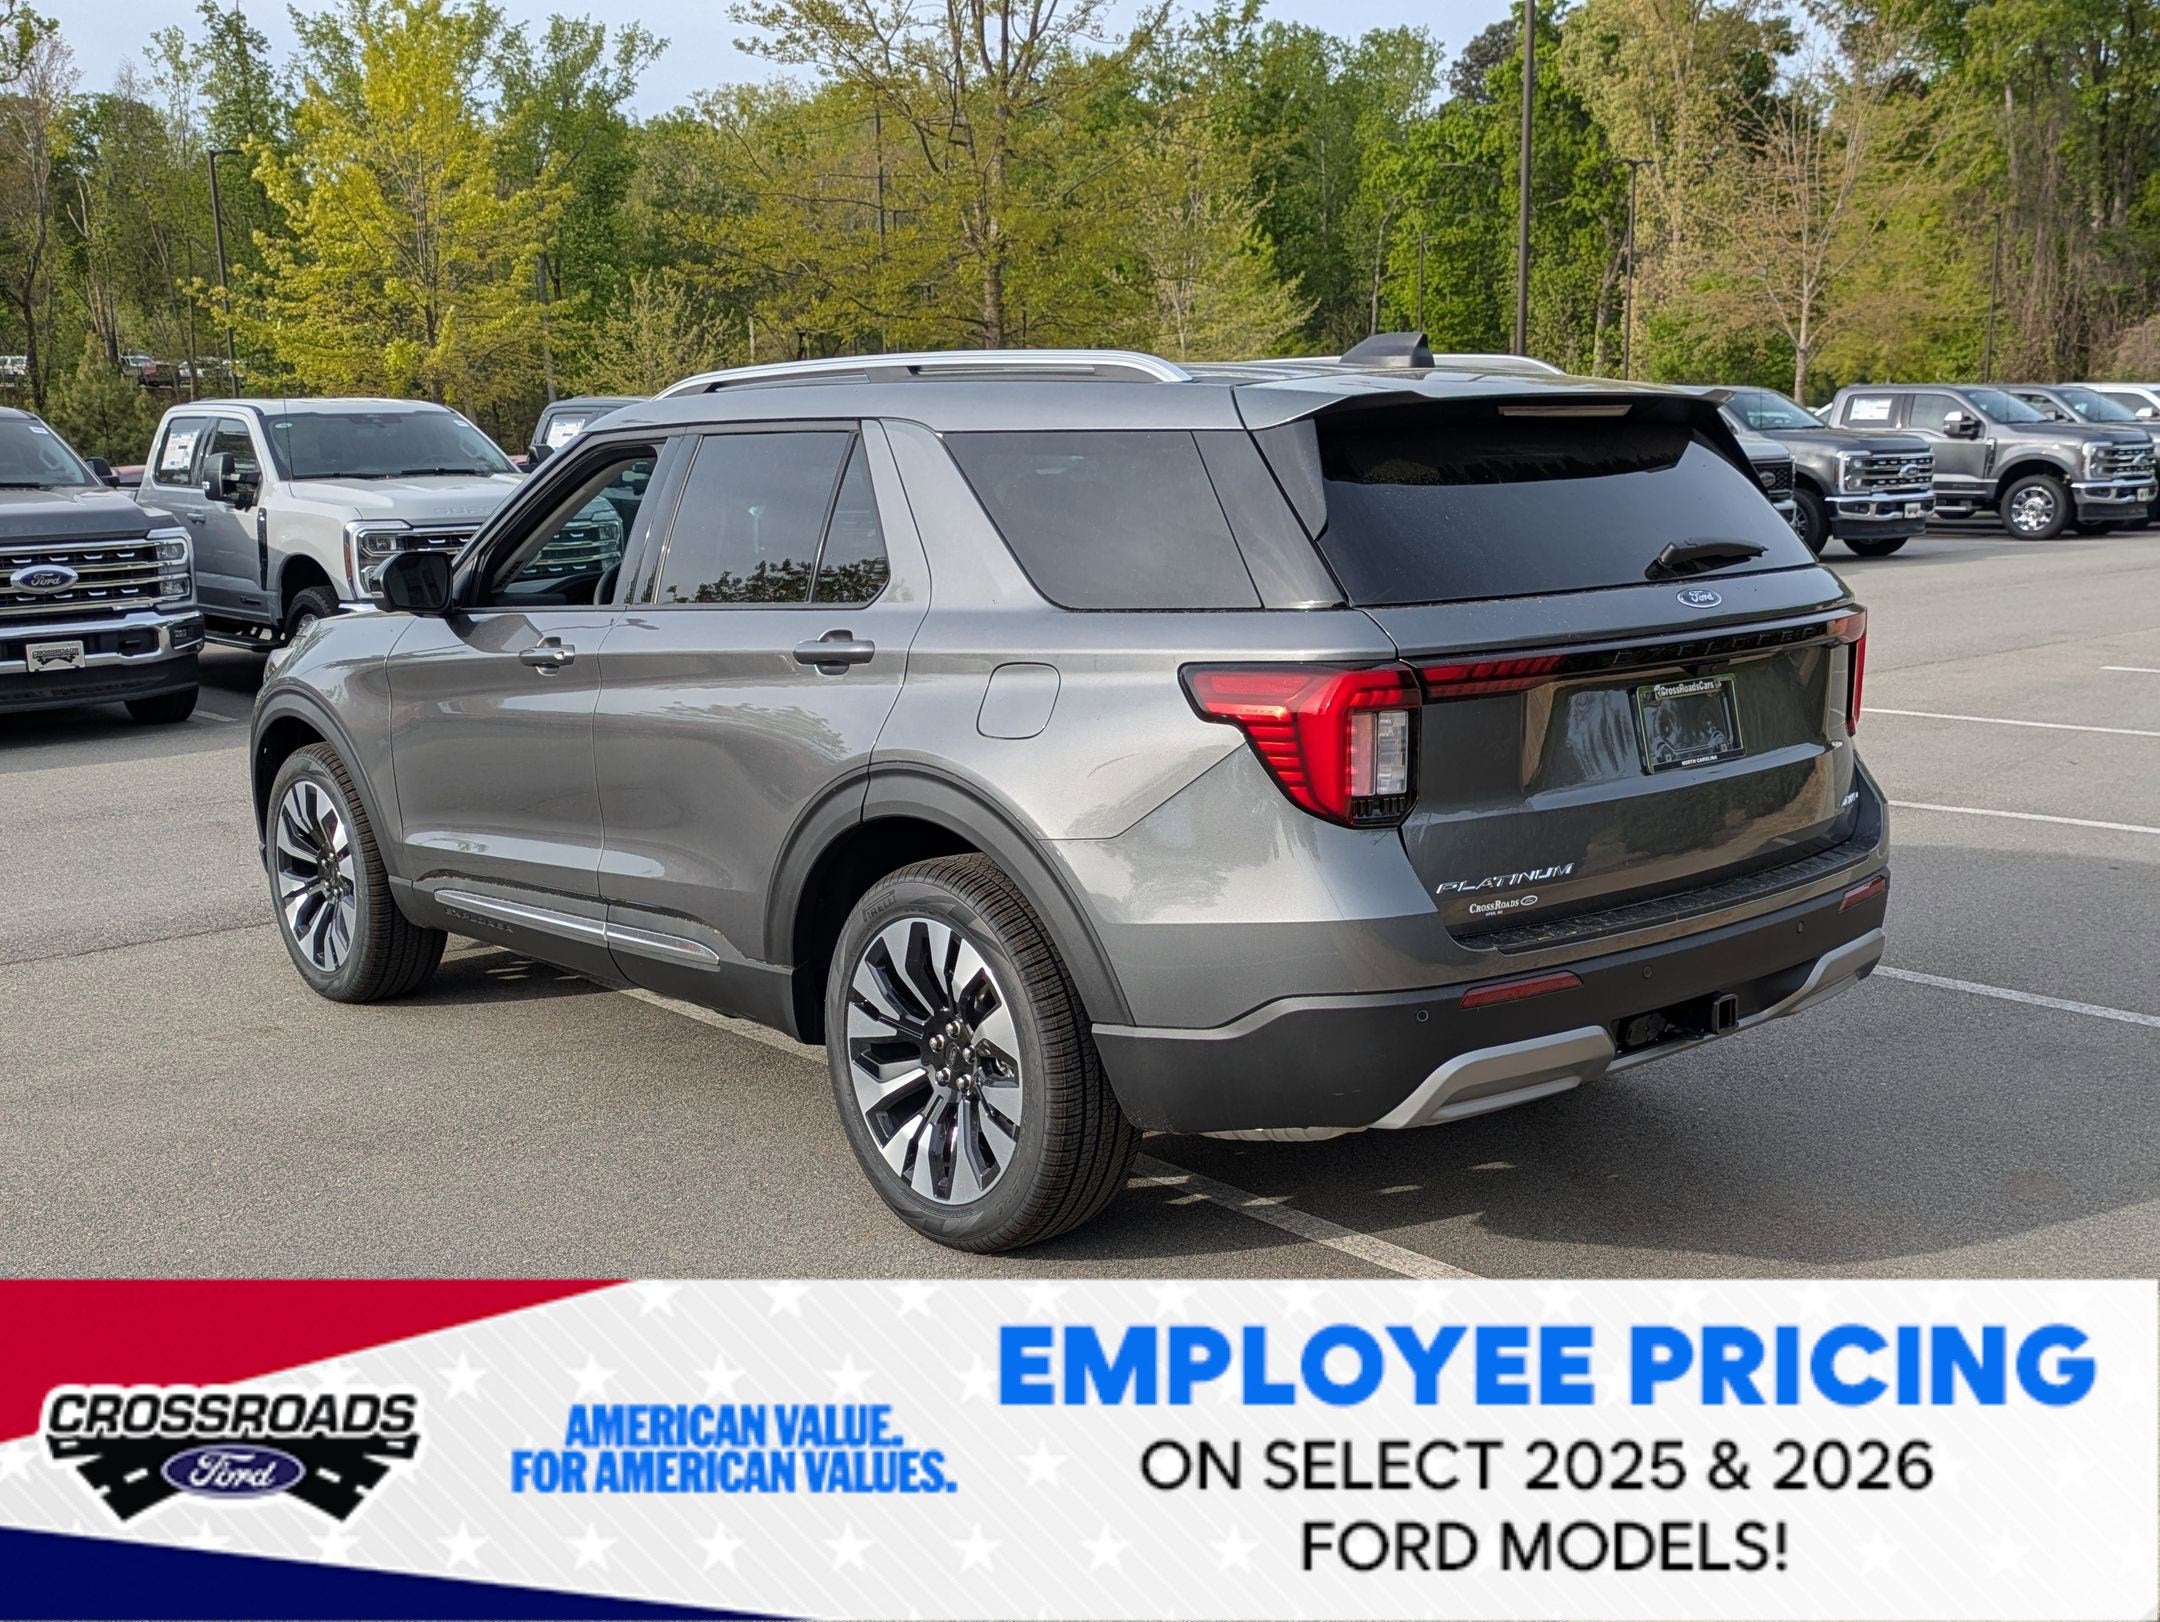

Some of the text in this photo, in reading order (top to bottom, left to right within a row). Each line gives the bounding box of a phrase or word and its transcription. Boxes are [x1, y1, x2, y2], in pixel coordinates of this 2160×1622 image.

[31, 573, 61, 586] Ford
[1688, 590, 1714, 602] Ford
[32, 647, 79, 659] CROSSROADS
[1436, 862, 1576, 895] PLATINUM
[863, 889, 896, 923] PIRELLI
